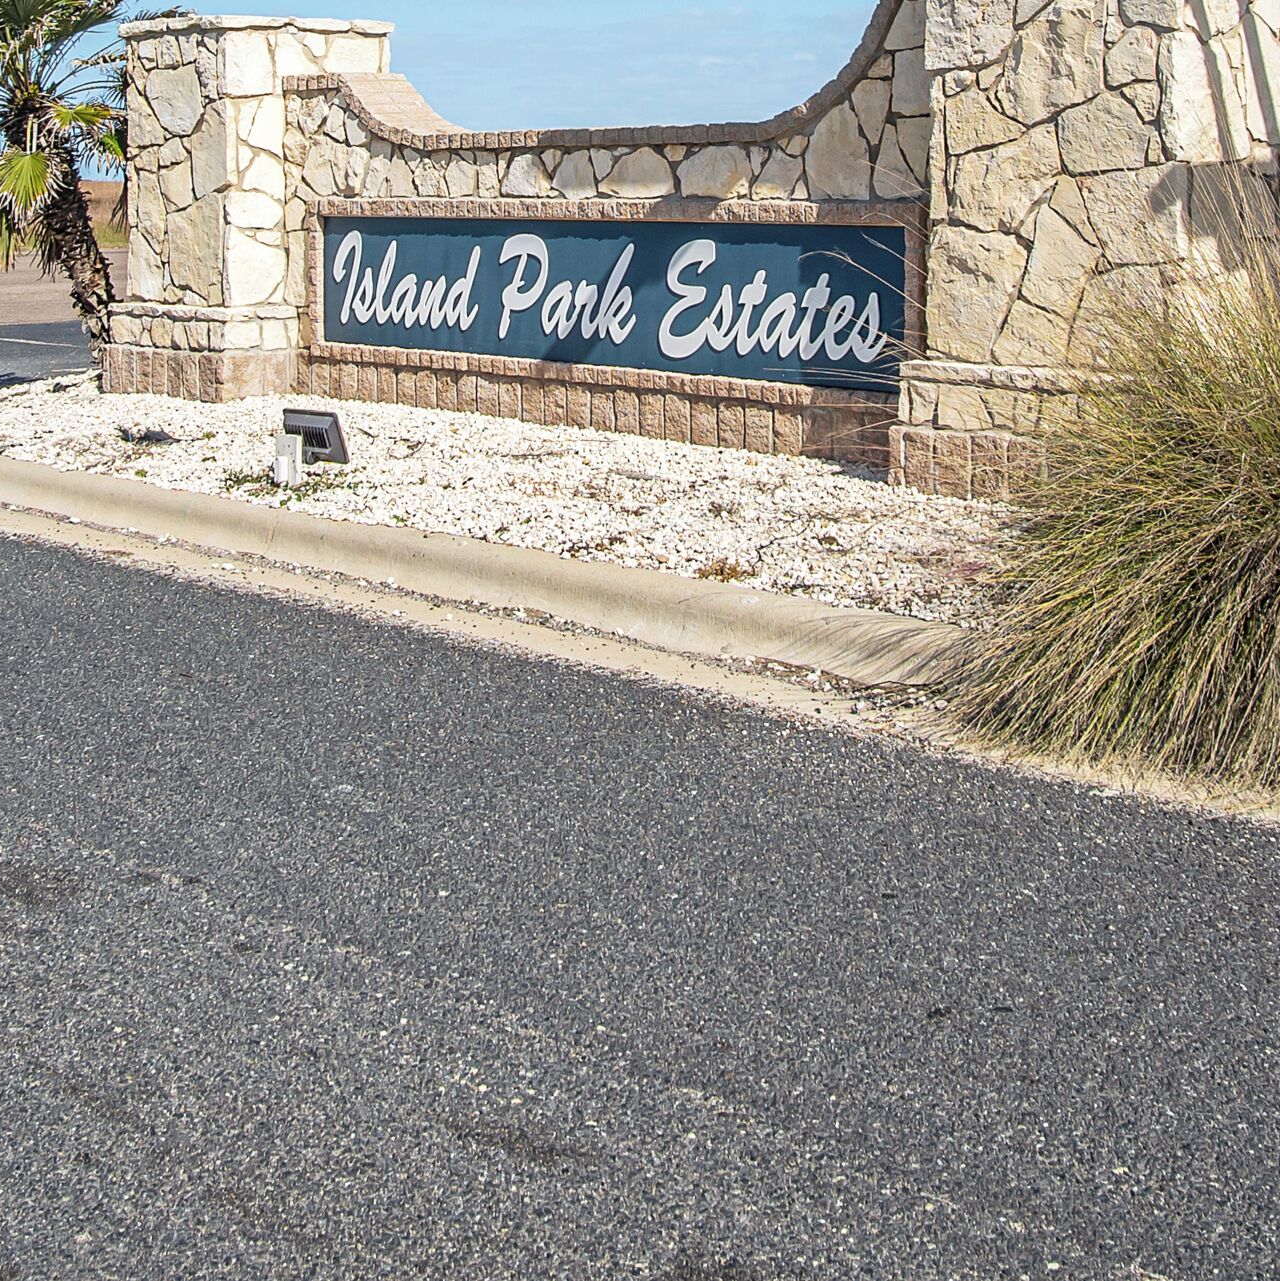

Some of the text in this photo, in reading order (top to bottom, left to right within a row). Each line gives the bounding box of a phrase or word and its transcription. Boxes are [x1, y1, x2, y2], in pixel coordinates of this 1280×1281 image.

[333, 230, 888, 362] Island Park Estates
